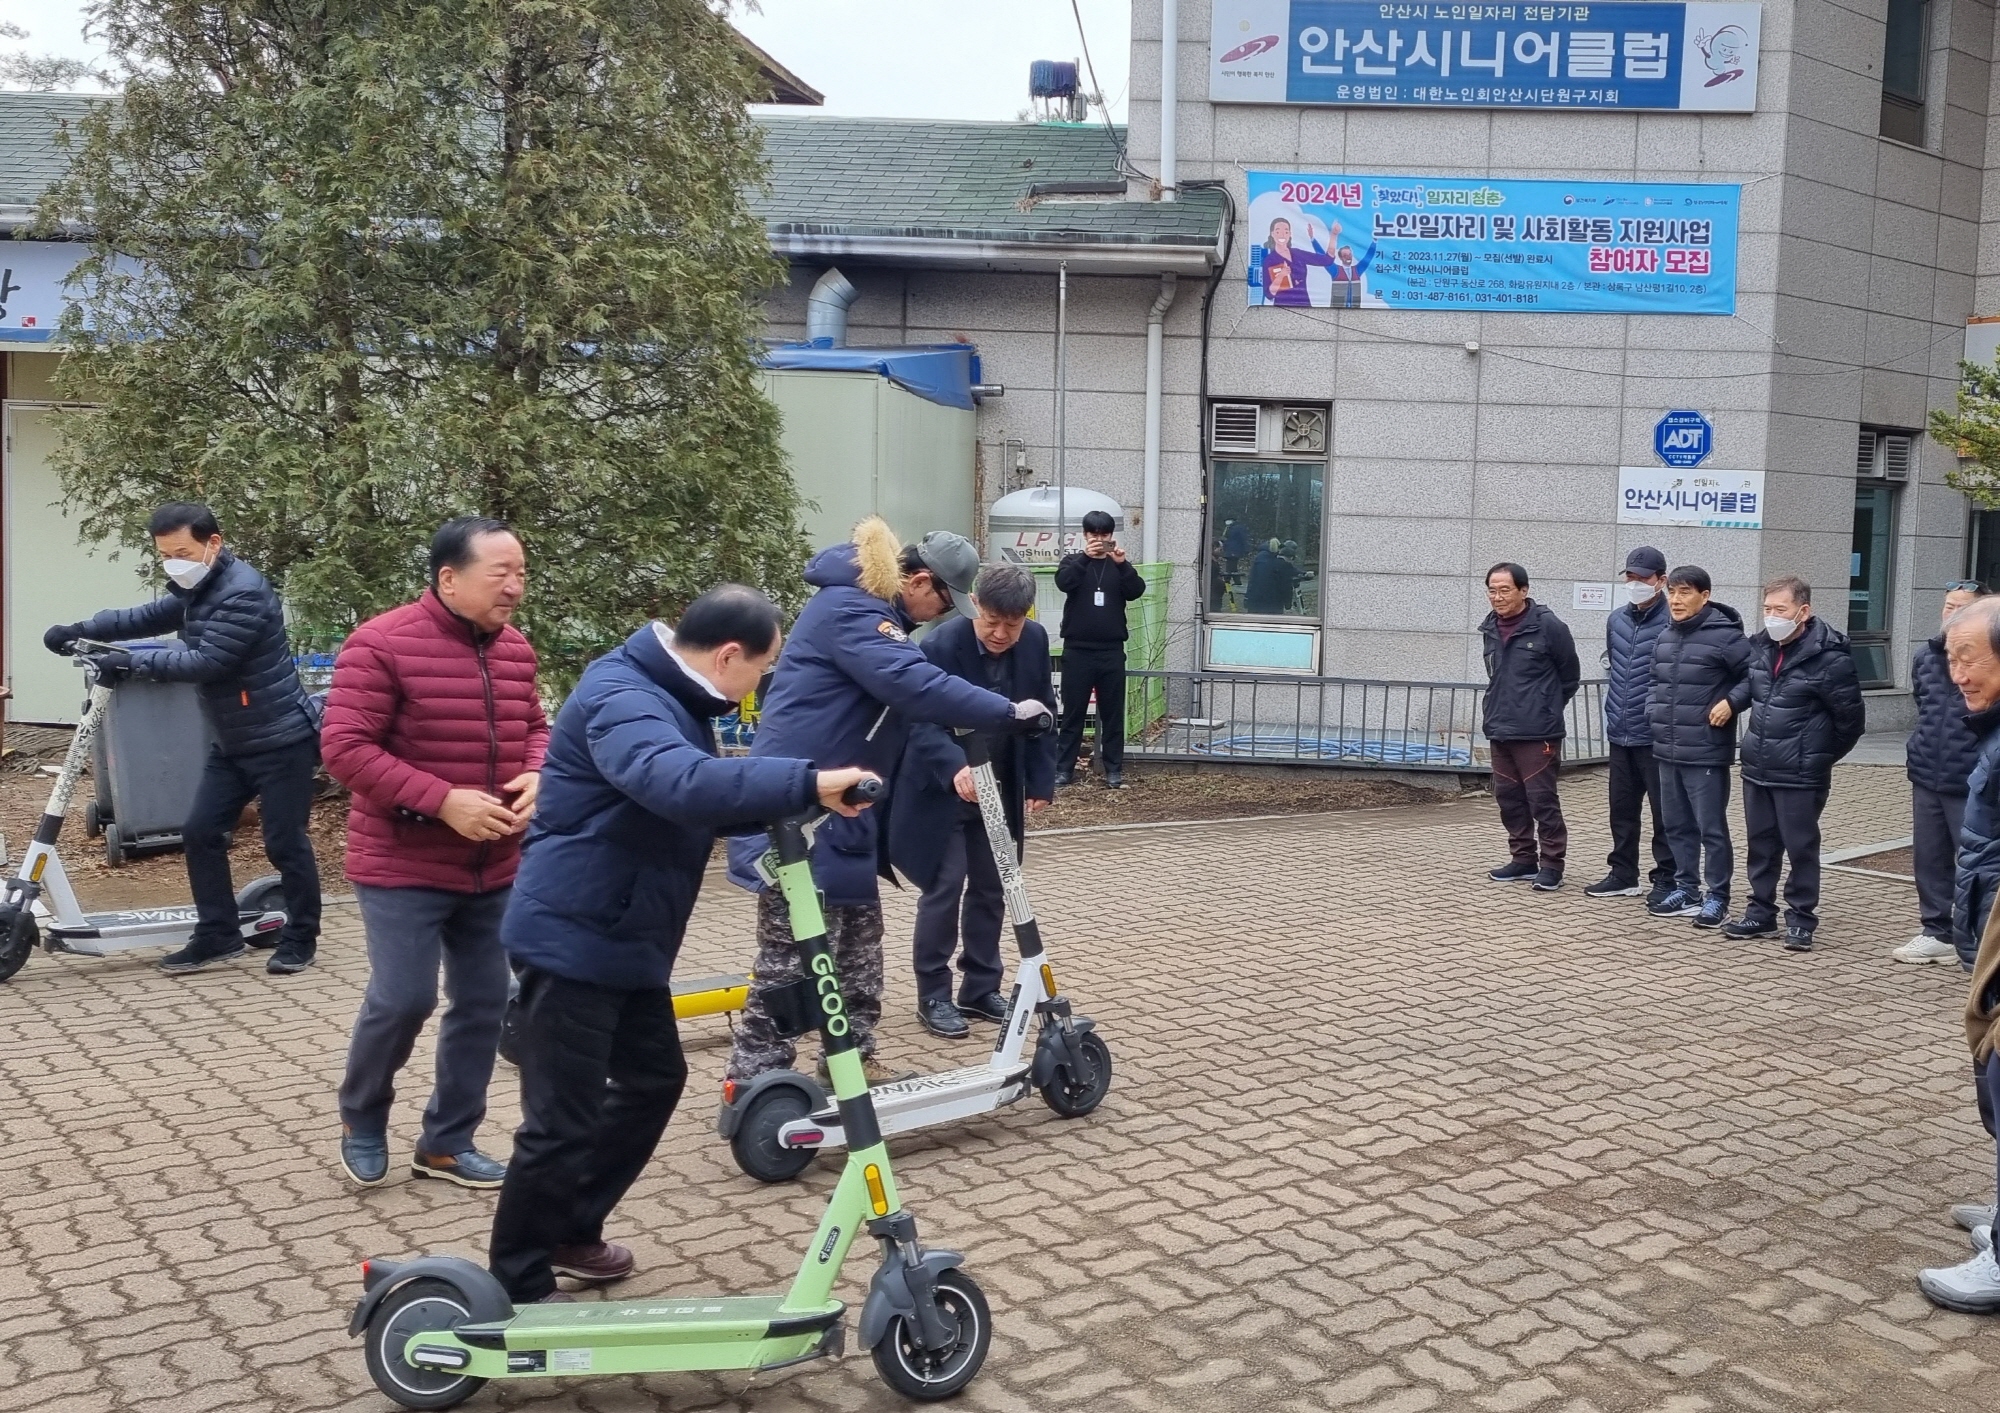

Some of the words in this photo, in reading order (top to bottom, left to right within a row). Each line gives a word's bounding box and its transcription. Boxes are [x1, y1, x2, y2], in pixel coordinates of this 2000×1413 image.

[1379, 4, 1428, 19] 안산시
[1433, 5, 1516, 20] 노인일자리
[1523, 6, 1590, 21] 전담기관
[1299, 26, 1669, 79] 안산시니어클럽
[1336, 84, 1398, 100] 운영법인
[1413, 86, 1619, 104] 대한노인회안산시단원구지회
[1280, 182, 1362, 208] 2024년
[1377, 188, 1419, 204] 찾았다!
[1426, 190, 1469, 206] 일자리
[1471, 187, 1504, 206] 청춘
[1373, 213, 1486, 240] 노인일자리
[1493, 216, 1515, 241] 및
[1521, 216, 1613, 243] 사회활동
[1619, 218, 1711, 245] 지원사업
[1408, 251, 1472, 263] 2023.11.27(월)
[1483, 253, 1524, 264] 모집(선발)
[1526, 254, 1553, 265] 완료시
[1589, 247, 1659, 273] 참여자
[1665, 250, 1710, 275] 모집
[1375, 263, 1401, 274] 접수처
[1408, 265, 1469, 276] 안산시니어클럽
[1434, 277, 1458, 288] 단원구
[1460, 279, 1486, 289] 동산로
[1607, 282, 1633, 292] 상록구
[1407, 291, 1473, 303] 031-487-8161,
[1475, 293, 1539, 304] 031-401-8181
[1663, 428, 1703, 448] ADT
[1693, 478, 1720, 487] 인일자
[1625, 488, 1757, 513] 안산시니어클럽
[1016, 548, 1051, 558] gShin
[811, 953, 848, 1036] GCOO
